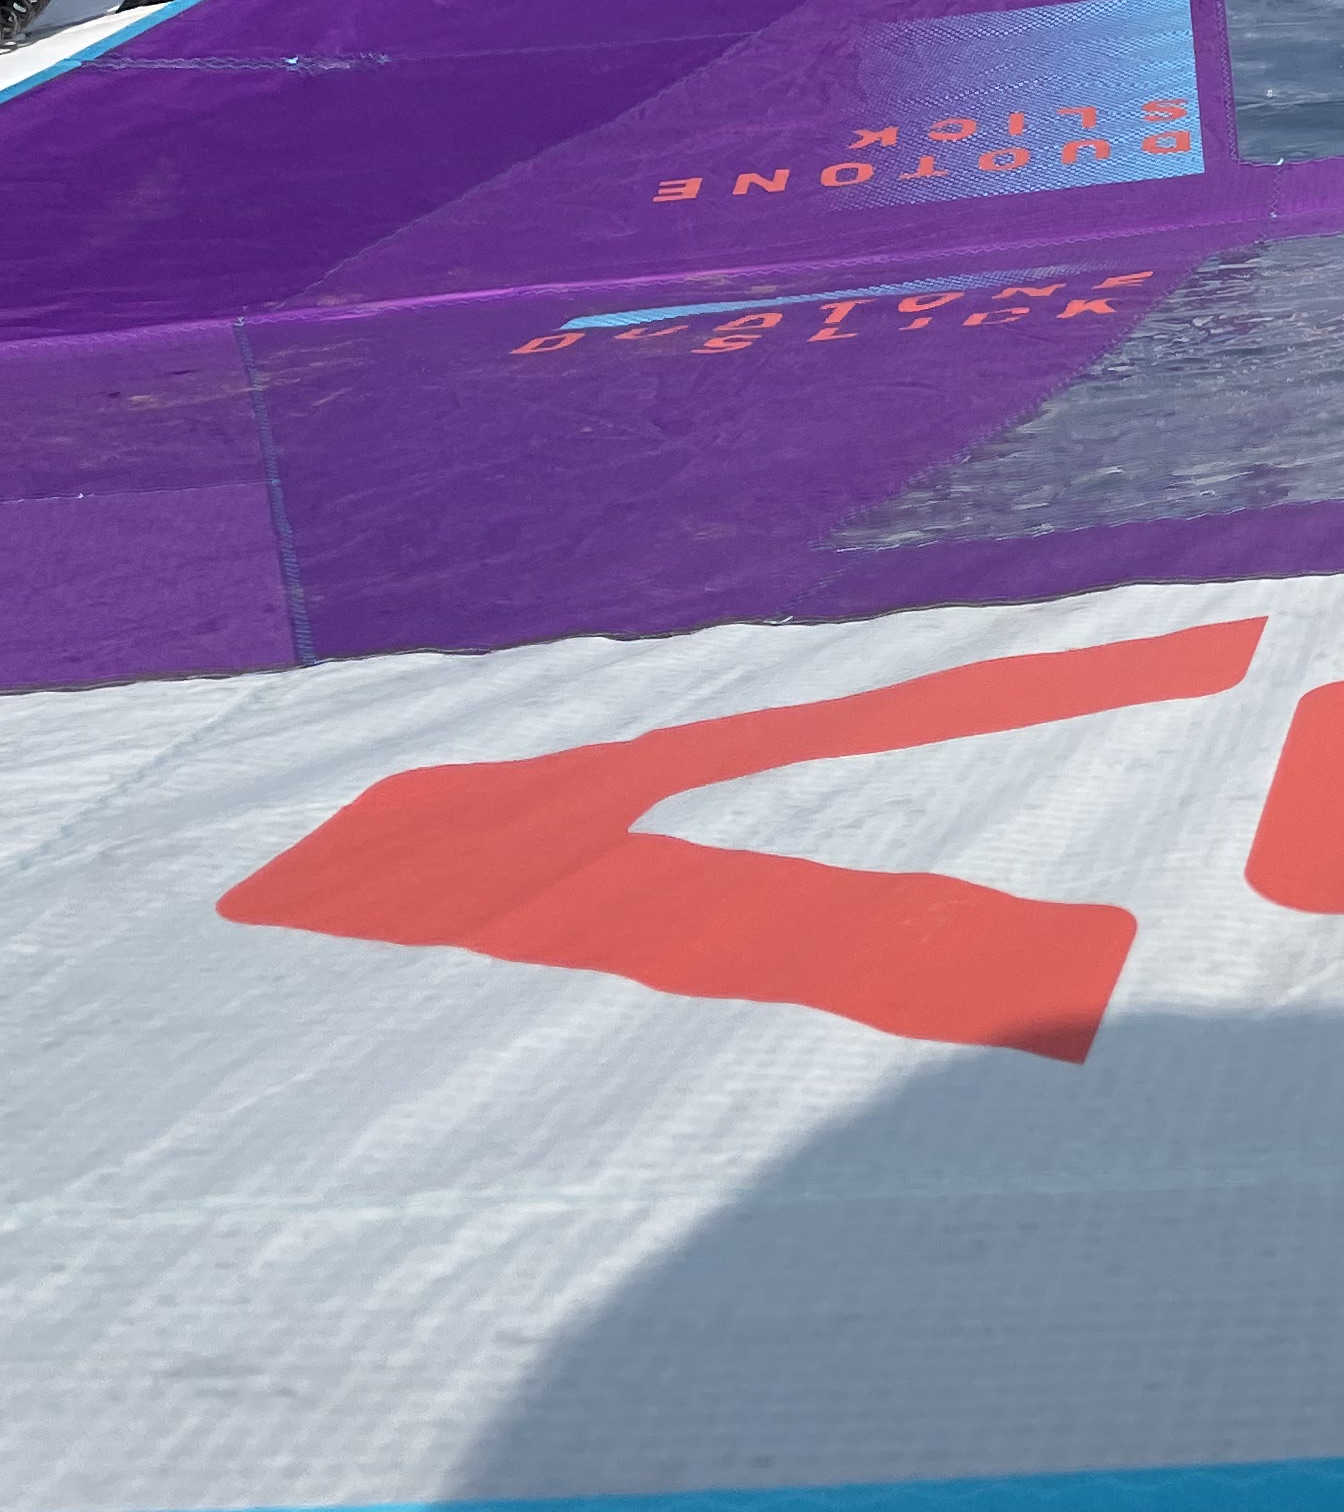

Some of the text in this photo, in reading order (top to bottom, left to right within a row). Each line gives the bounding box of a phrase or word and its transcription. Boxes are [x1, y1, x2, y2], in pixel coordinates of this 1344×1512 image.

[847, 98, 1189, 150] SLICK
[651, 129, 1192, 203] DUOTONE
[509, 271, 1154, 355] DUOTONE
[690, 297, 1120, 355] SLICK
